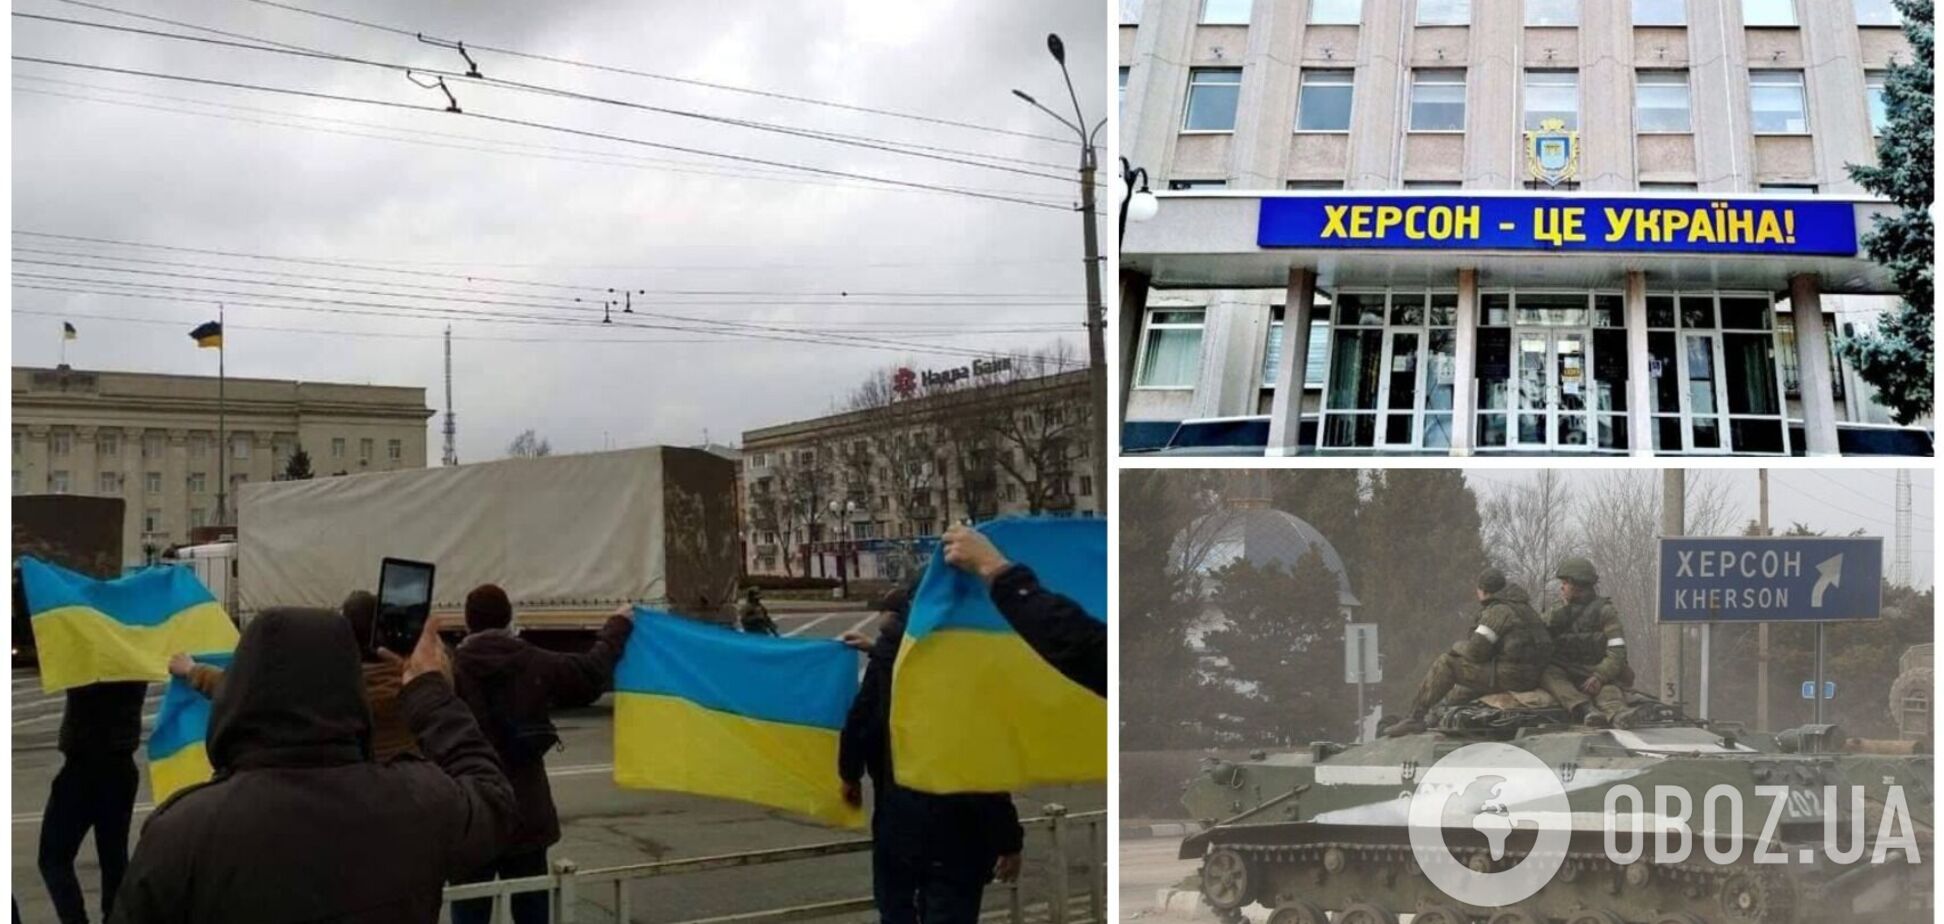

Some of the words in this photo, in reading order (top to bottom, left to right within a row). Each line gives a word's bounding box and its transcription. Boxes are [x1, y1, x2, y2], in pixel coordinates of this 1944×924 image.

[1320, 205, 1480, 240] ХЕРСОН
[1499, 222, 1515, 231] -
[1533, 206, 1586, 246] ЦЕ
[1604, 202, 1797, 245] УКРАЇНА!
[1676, 550, 1802, 578] ХЕРСОН
[1674, 588, 1789, 609] KHERSON
